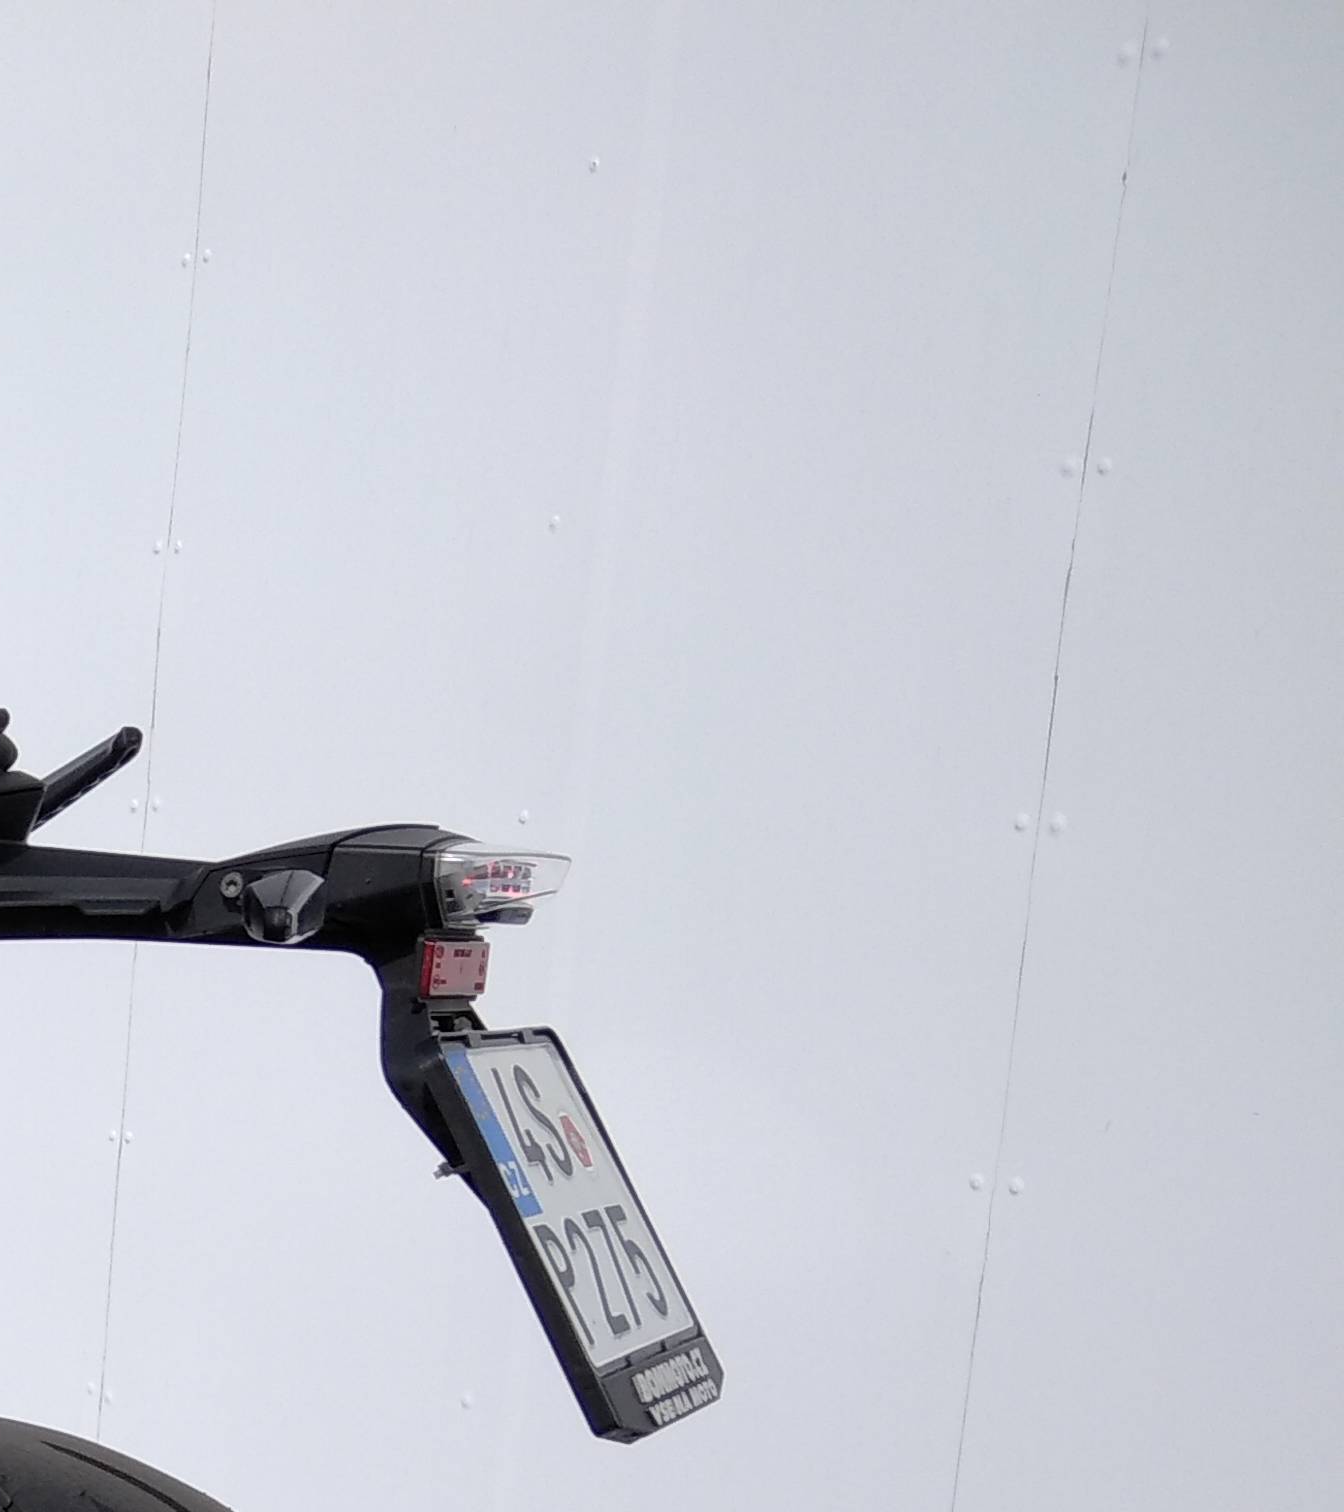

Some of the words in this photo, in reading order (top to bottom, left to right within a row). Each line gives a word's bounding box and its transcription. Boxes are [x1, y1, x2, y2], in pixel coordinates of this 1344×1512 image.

[491, 1064, 573, 1182] 4S
[499, 1160, 531, 1198] CZ
[533, 1204, 667, 1346] P275
